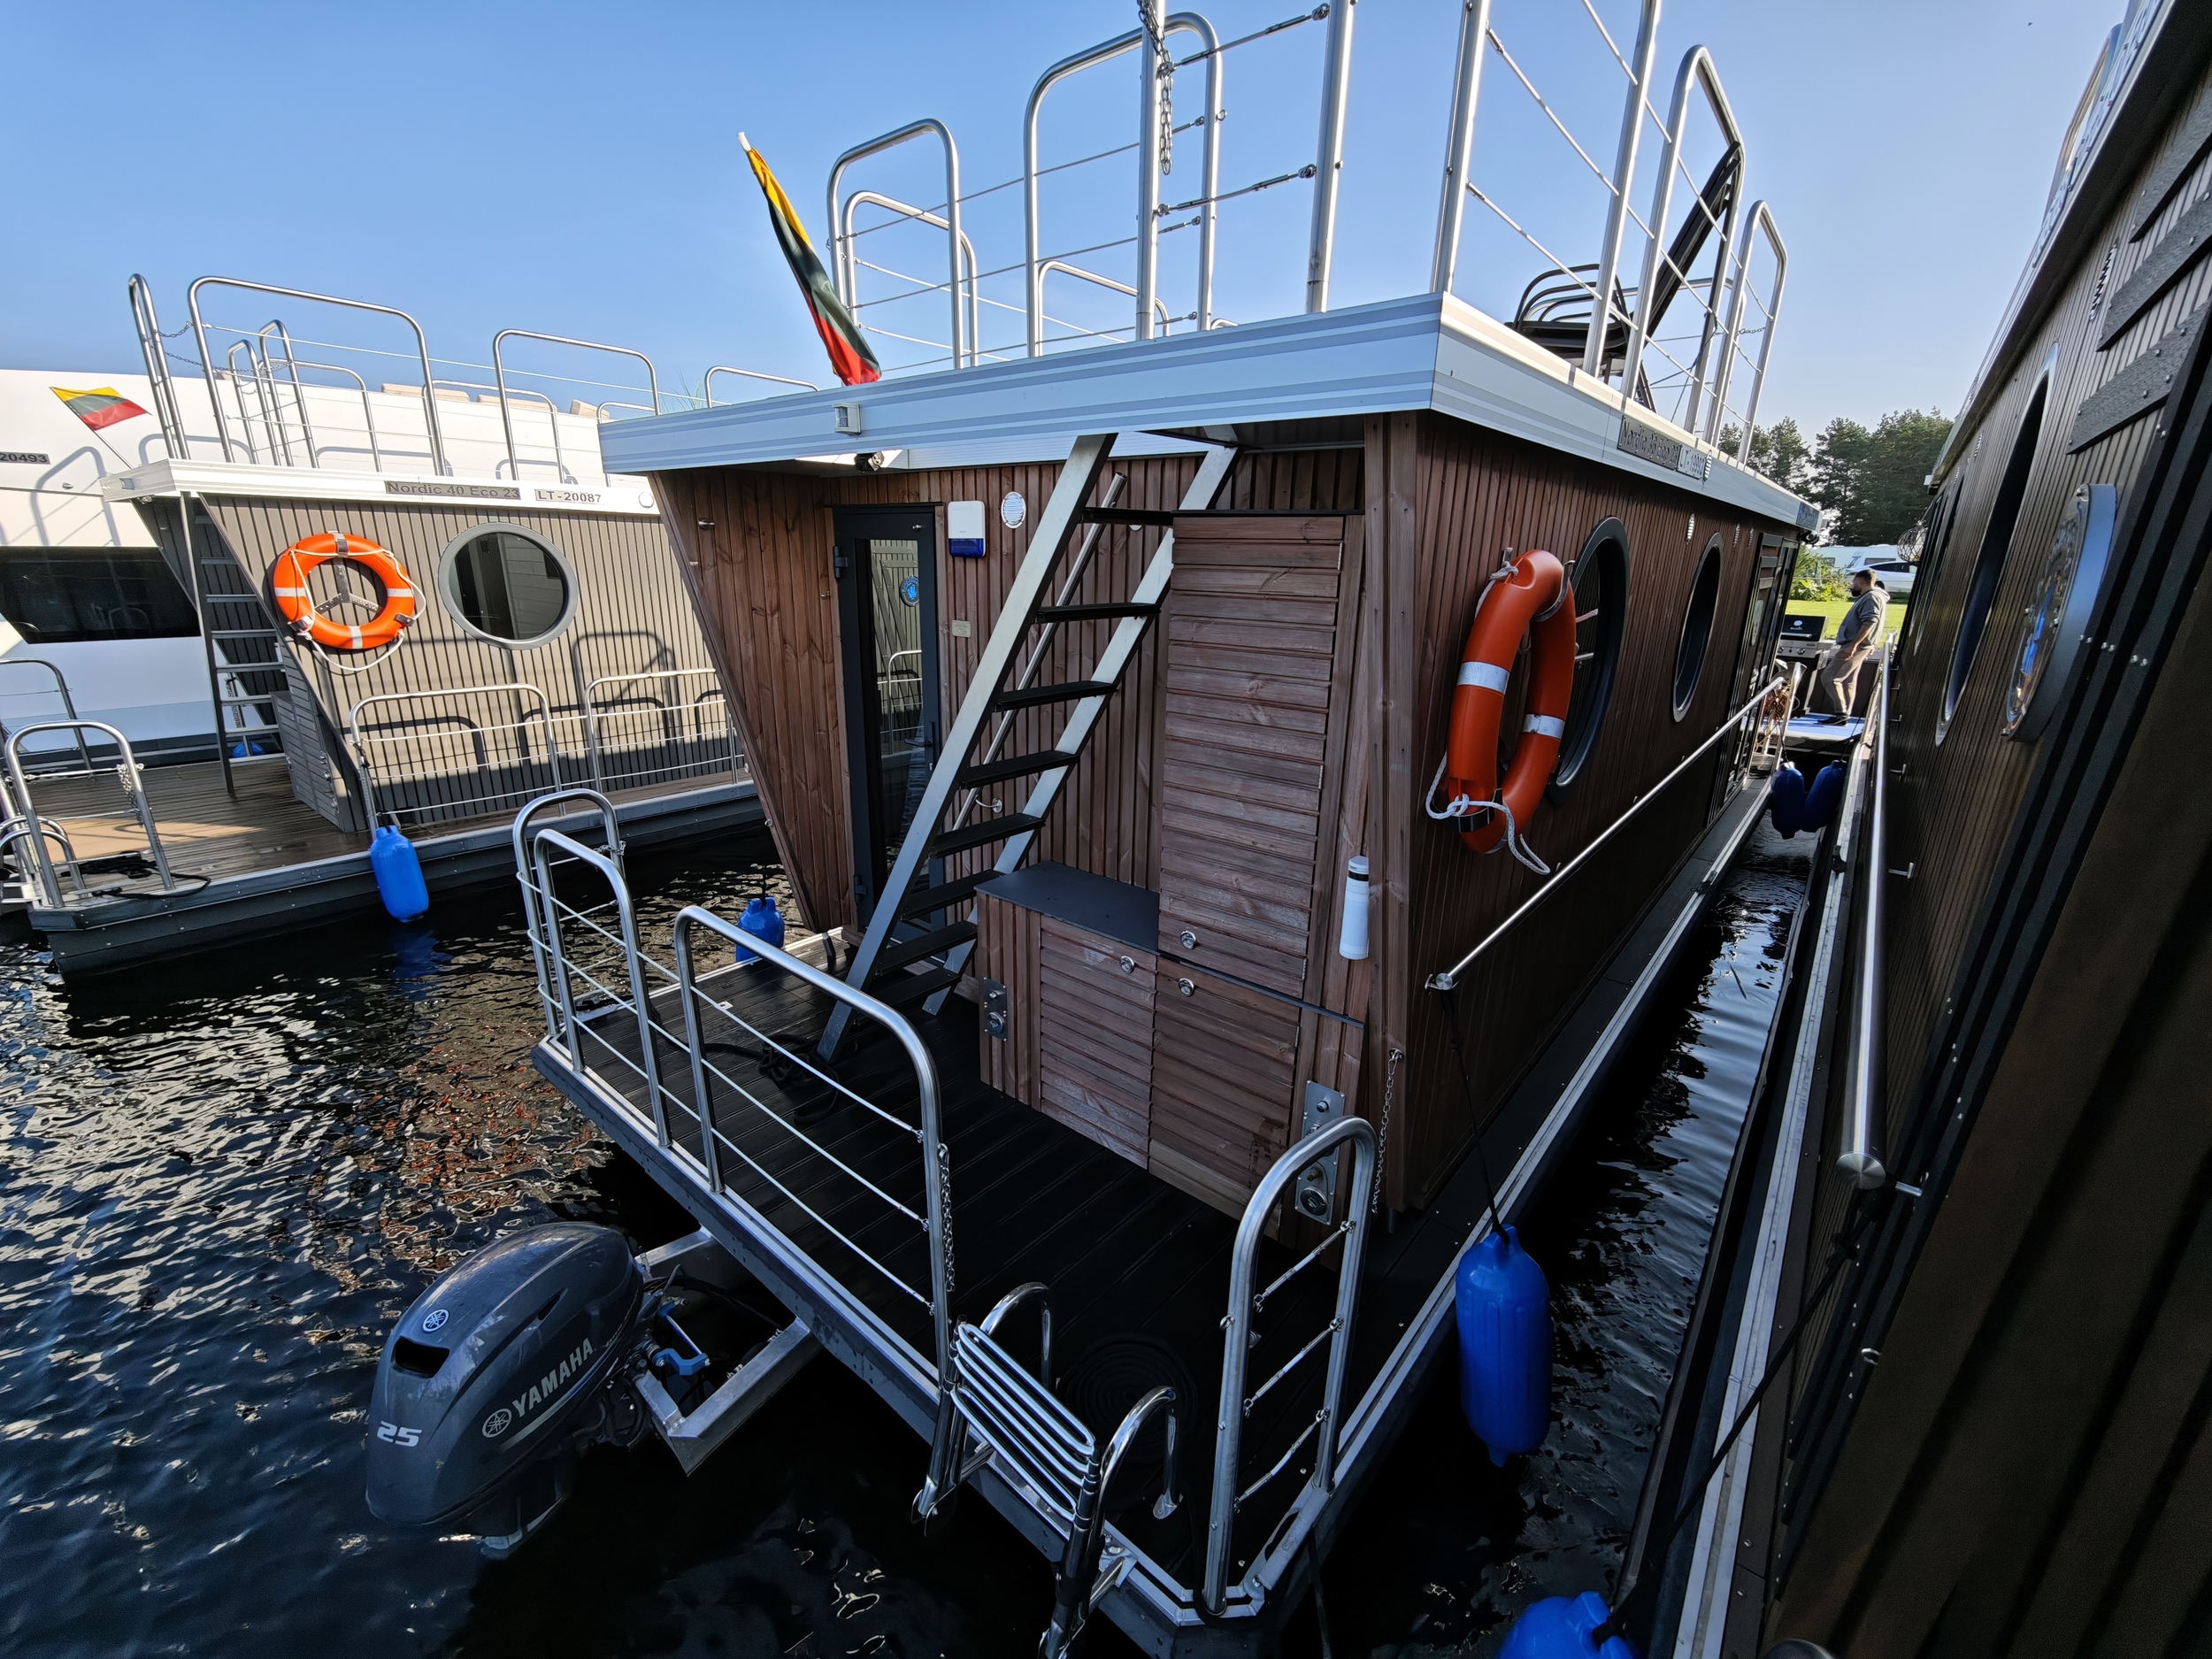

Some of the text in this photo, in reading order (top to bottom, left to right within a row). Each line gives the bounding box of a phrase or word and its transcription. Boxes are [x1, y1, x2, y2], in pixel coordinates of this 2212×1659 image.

[1621, 420, 1647, 452] Nordic
[1656, 437, 1671, 462] Eco
[0, 453, 48, 463] 20493
[387, 481, 520, 498] Nordic 40 Eco 23
[537, 490, 602, 503] LT-20087
[512, 1337, 595, 1417] YAMAHA
[376, 1420, 423, 1448] 25
